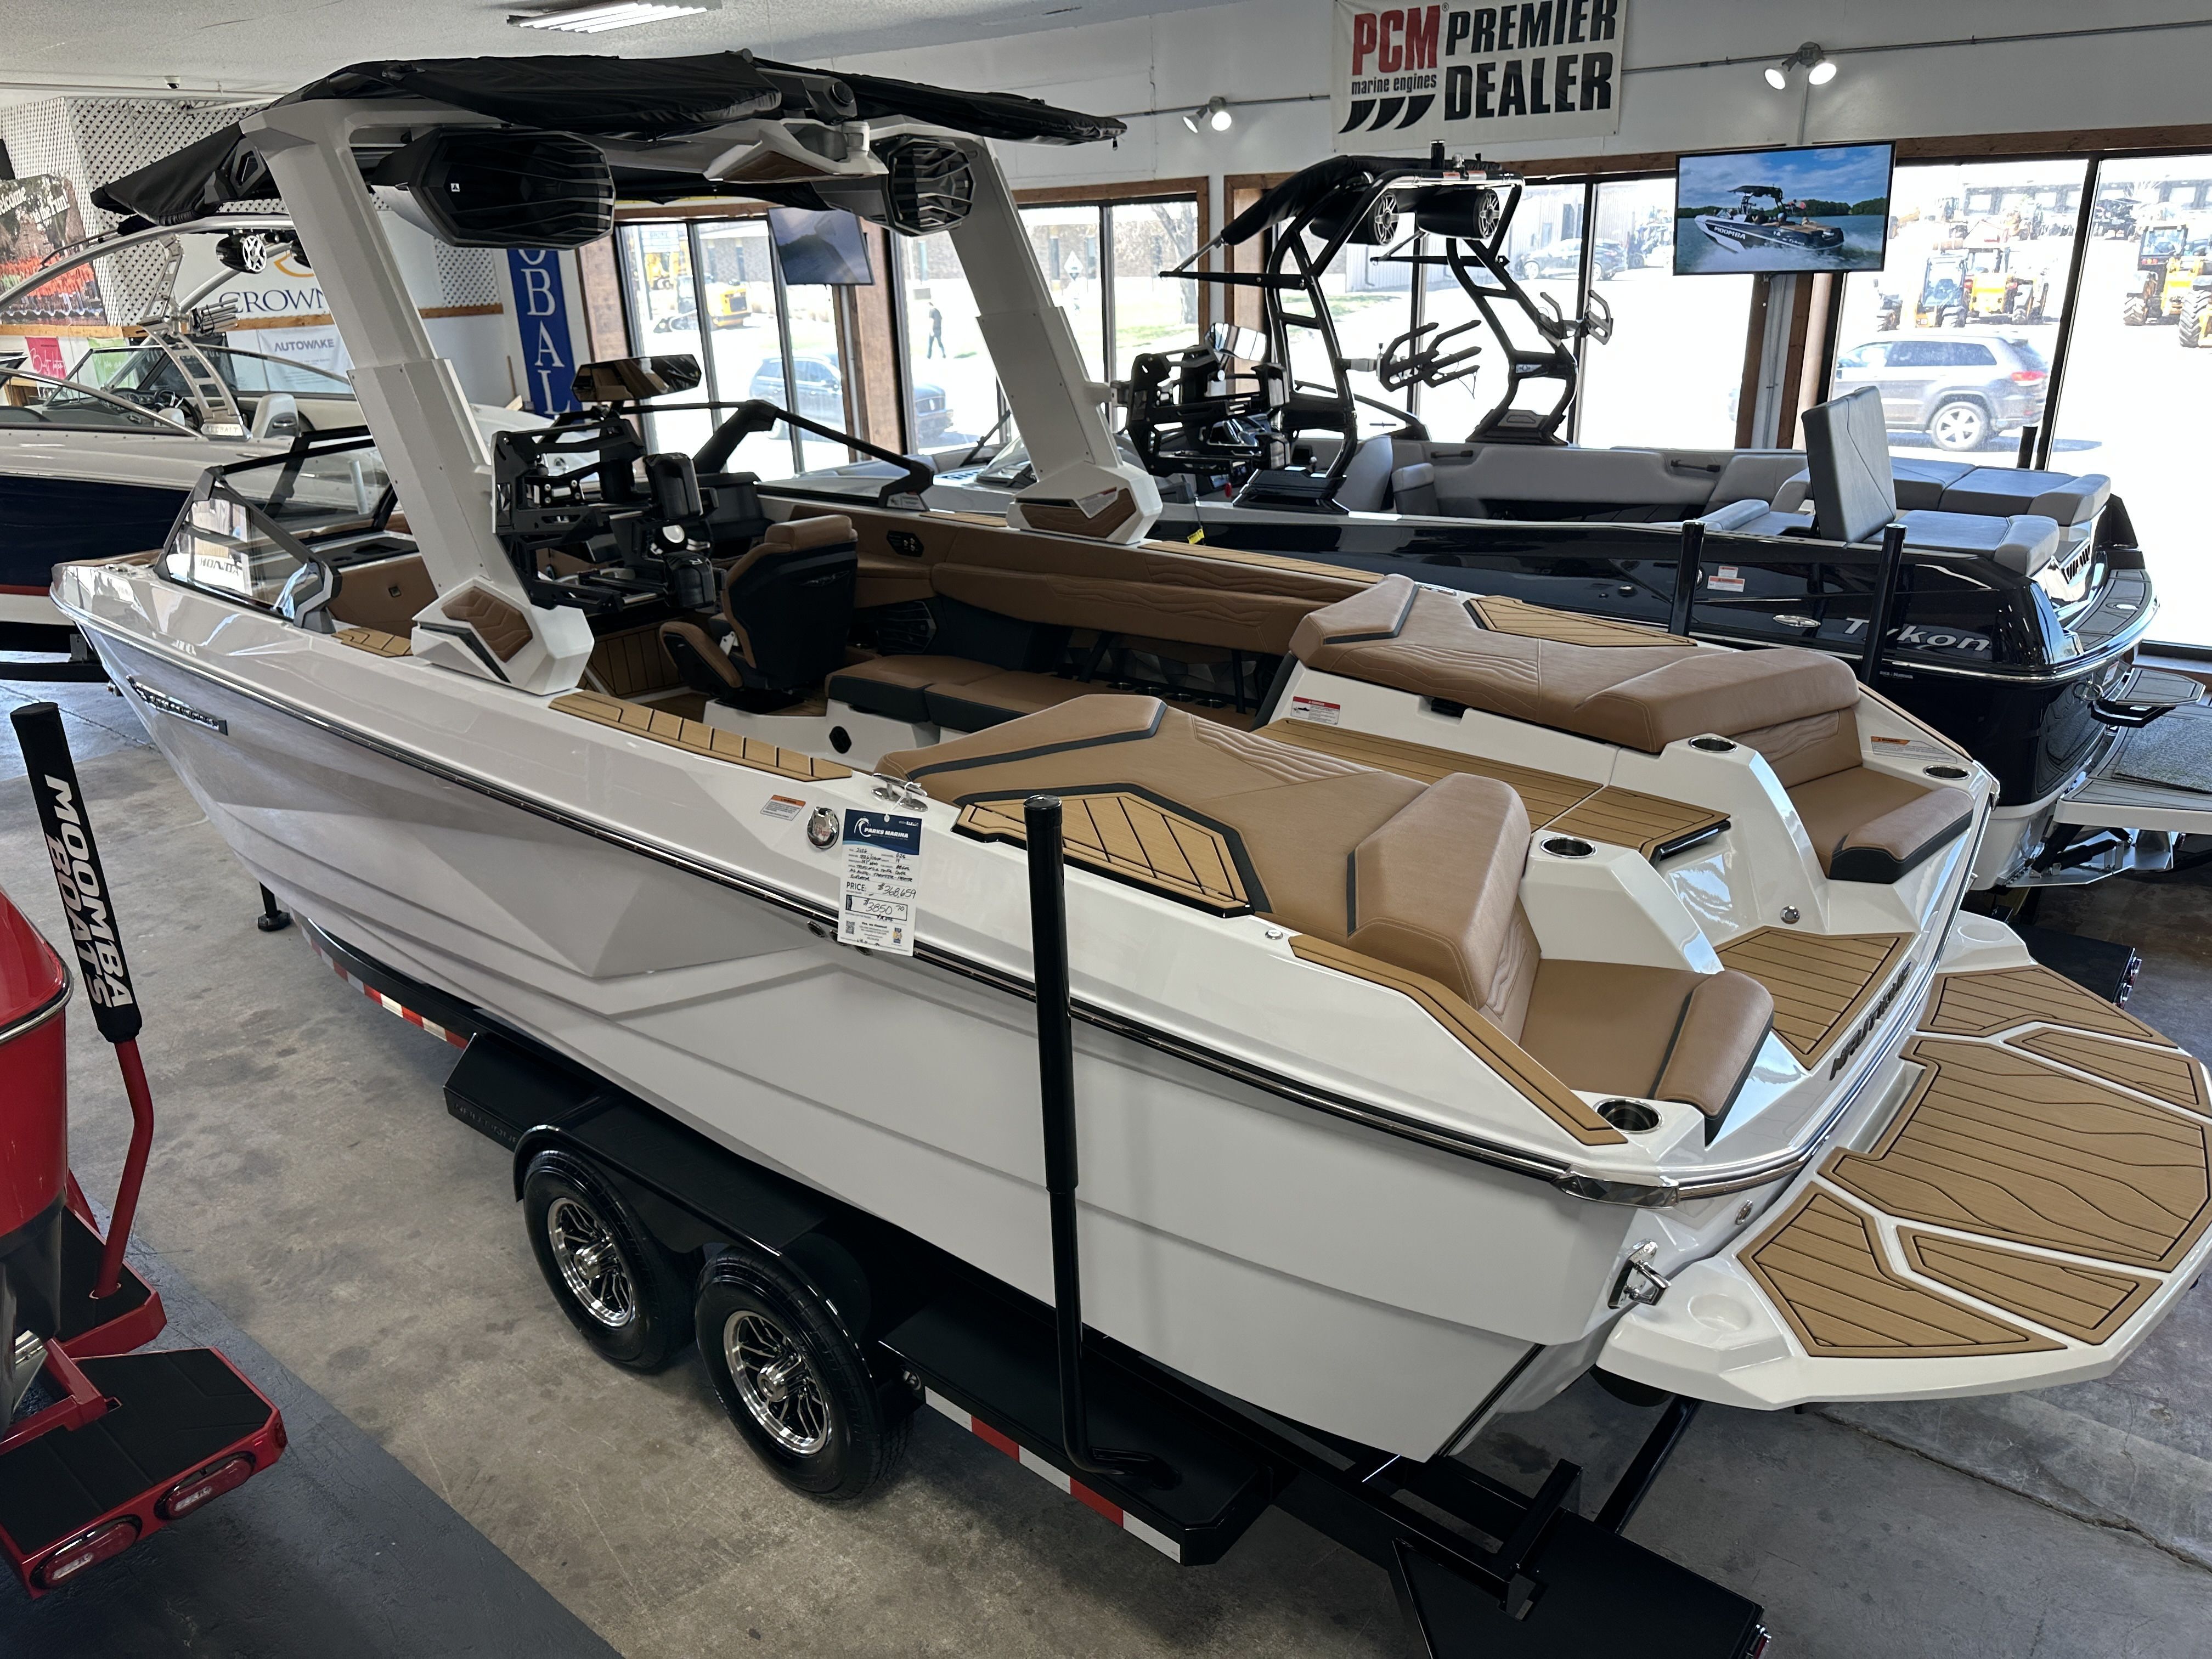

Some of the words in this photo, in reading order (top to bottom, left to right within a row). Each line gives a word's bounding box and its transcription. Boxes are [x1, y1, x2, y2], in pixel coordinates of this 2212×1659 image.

[1352, 5, 1440, 76] PCM
[1445, 0, 1617, 55] PREMIER
[1352, 78, 1390, 95] marine
[1393, 74, 1437, 93] engines
[1444, 52, 1613, 121] DEALER
[0, 187, 26, 216] elcome
[1714, 226, 1746, 240] MOOMBA
[274, 338, 335, 352] AUTOWAKE
[1844, 617, 1990, 651] Tkon
[44, 774, 133, 1007] MOOMBA
[46, 833, 112, 1008] BOATS
